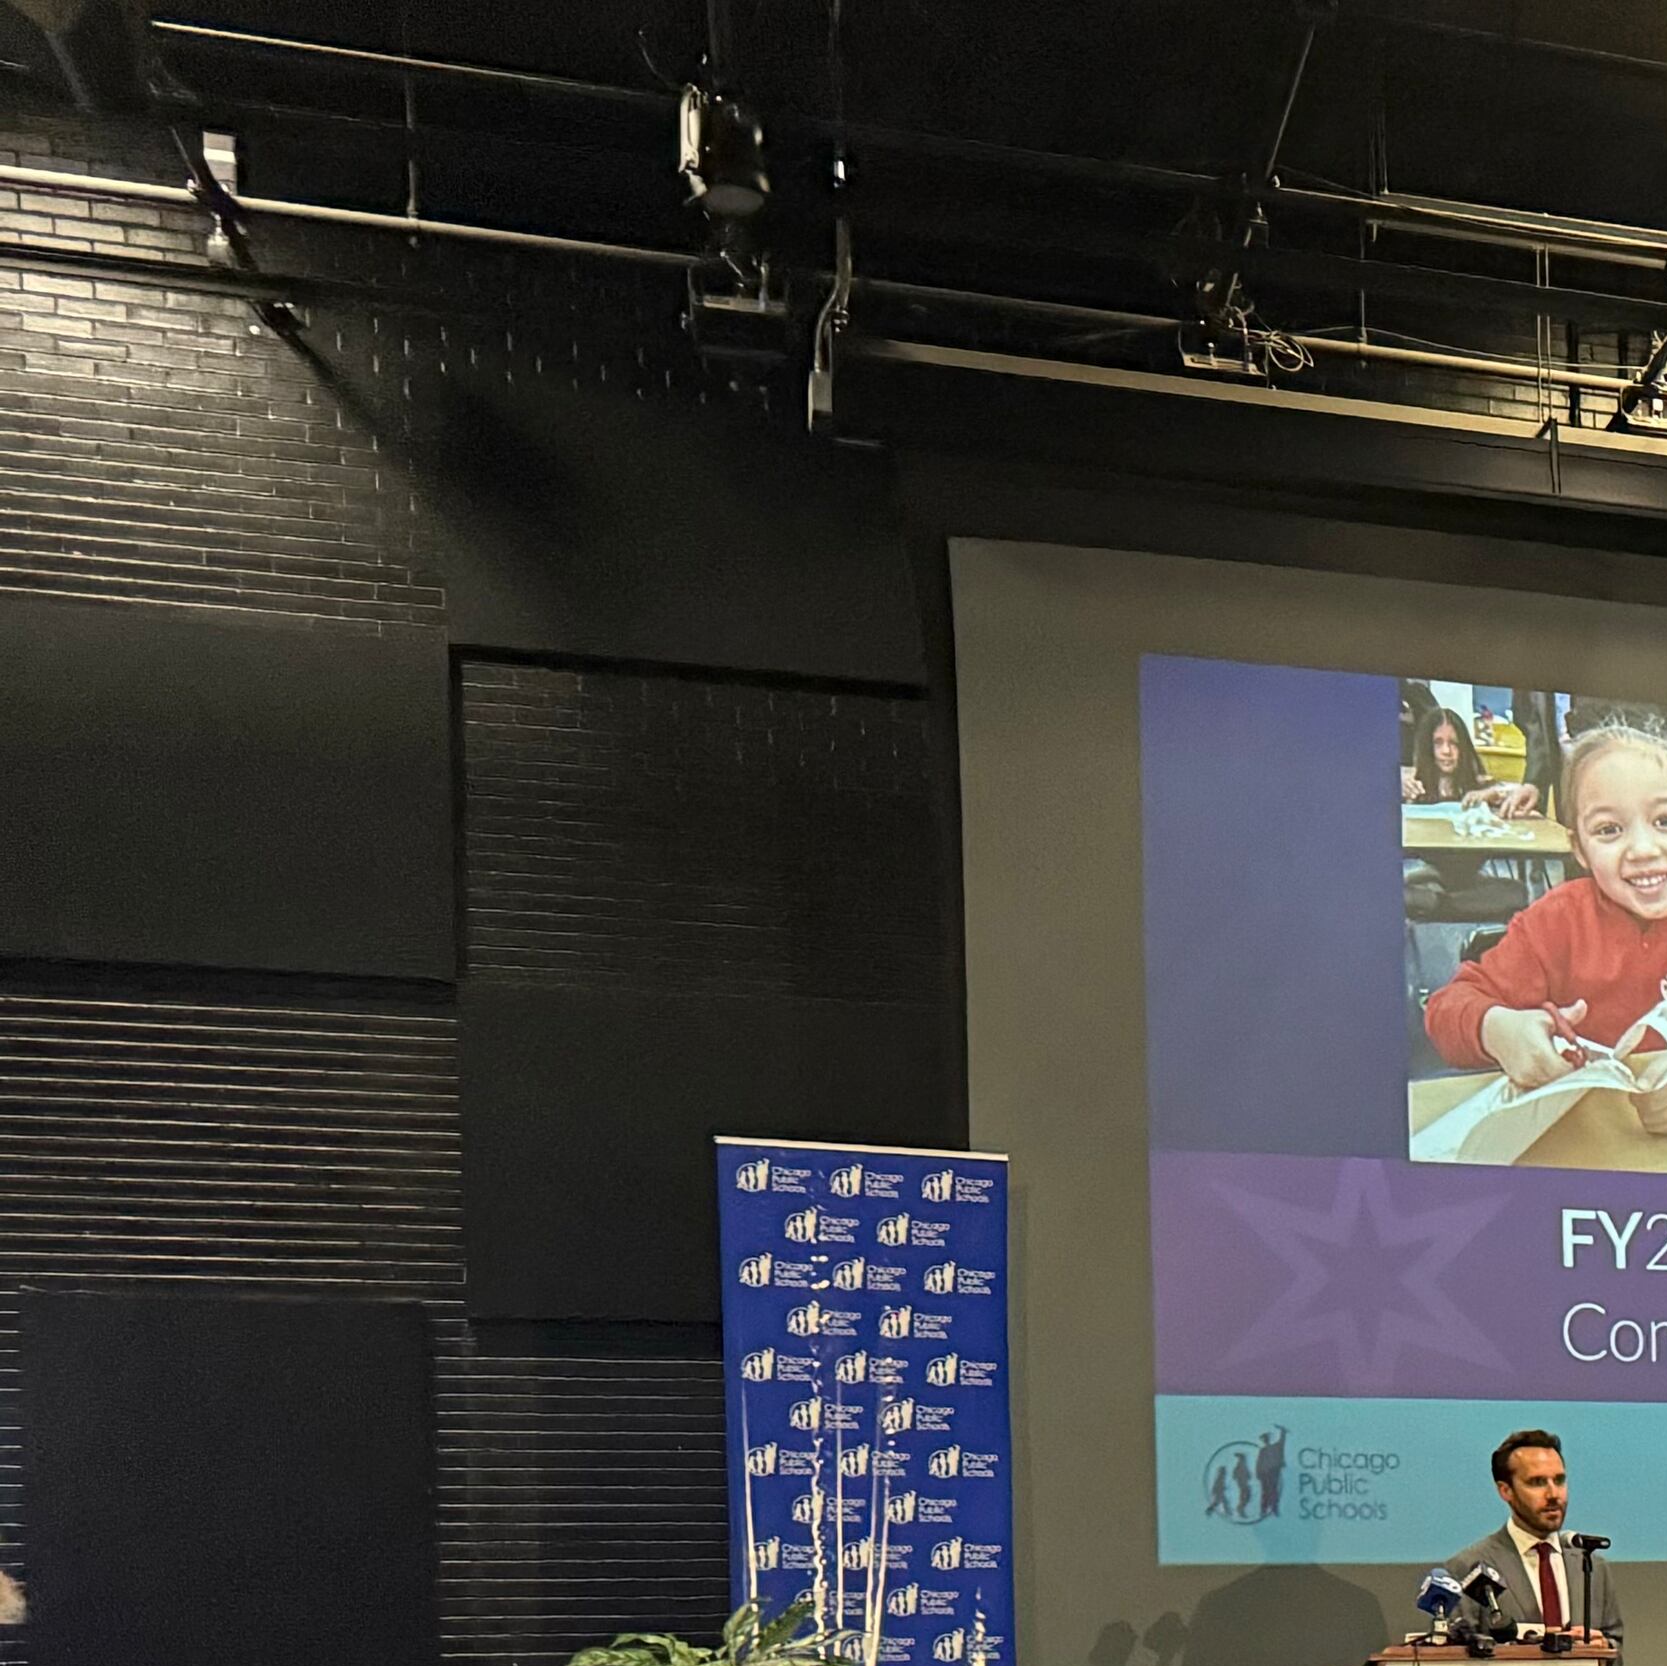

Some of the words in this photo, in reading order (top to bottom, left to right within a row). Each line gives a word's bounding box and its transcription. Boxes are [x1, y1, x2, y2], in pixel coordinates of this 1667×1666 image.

[1298, 1447, 1400, 1475] Chicago
[1299, 1473, 1369, 1496] Public
[1299, 1500, 1388, 1520] Schools
